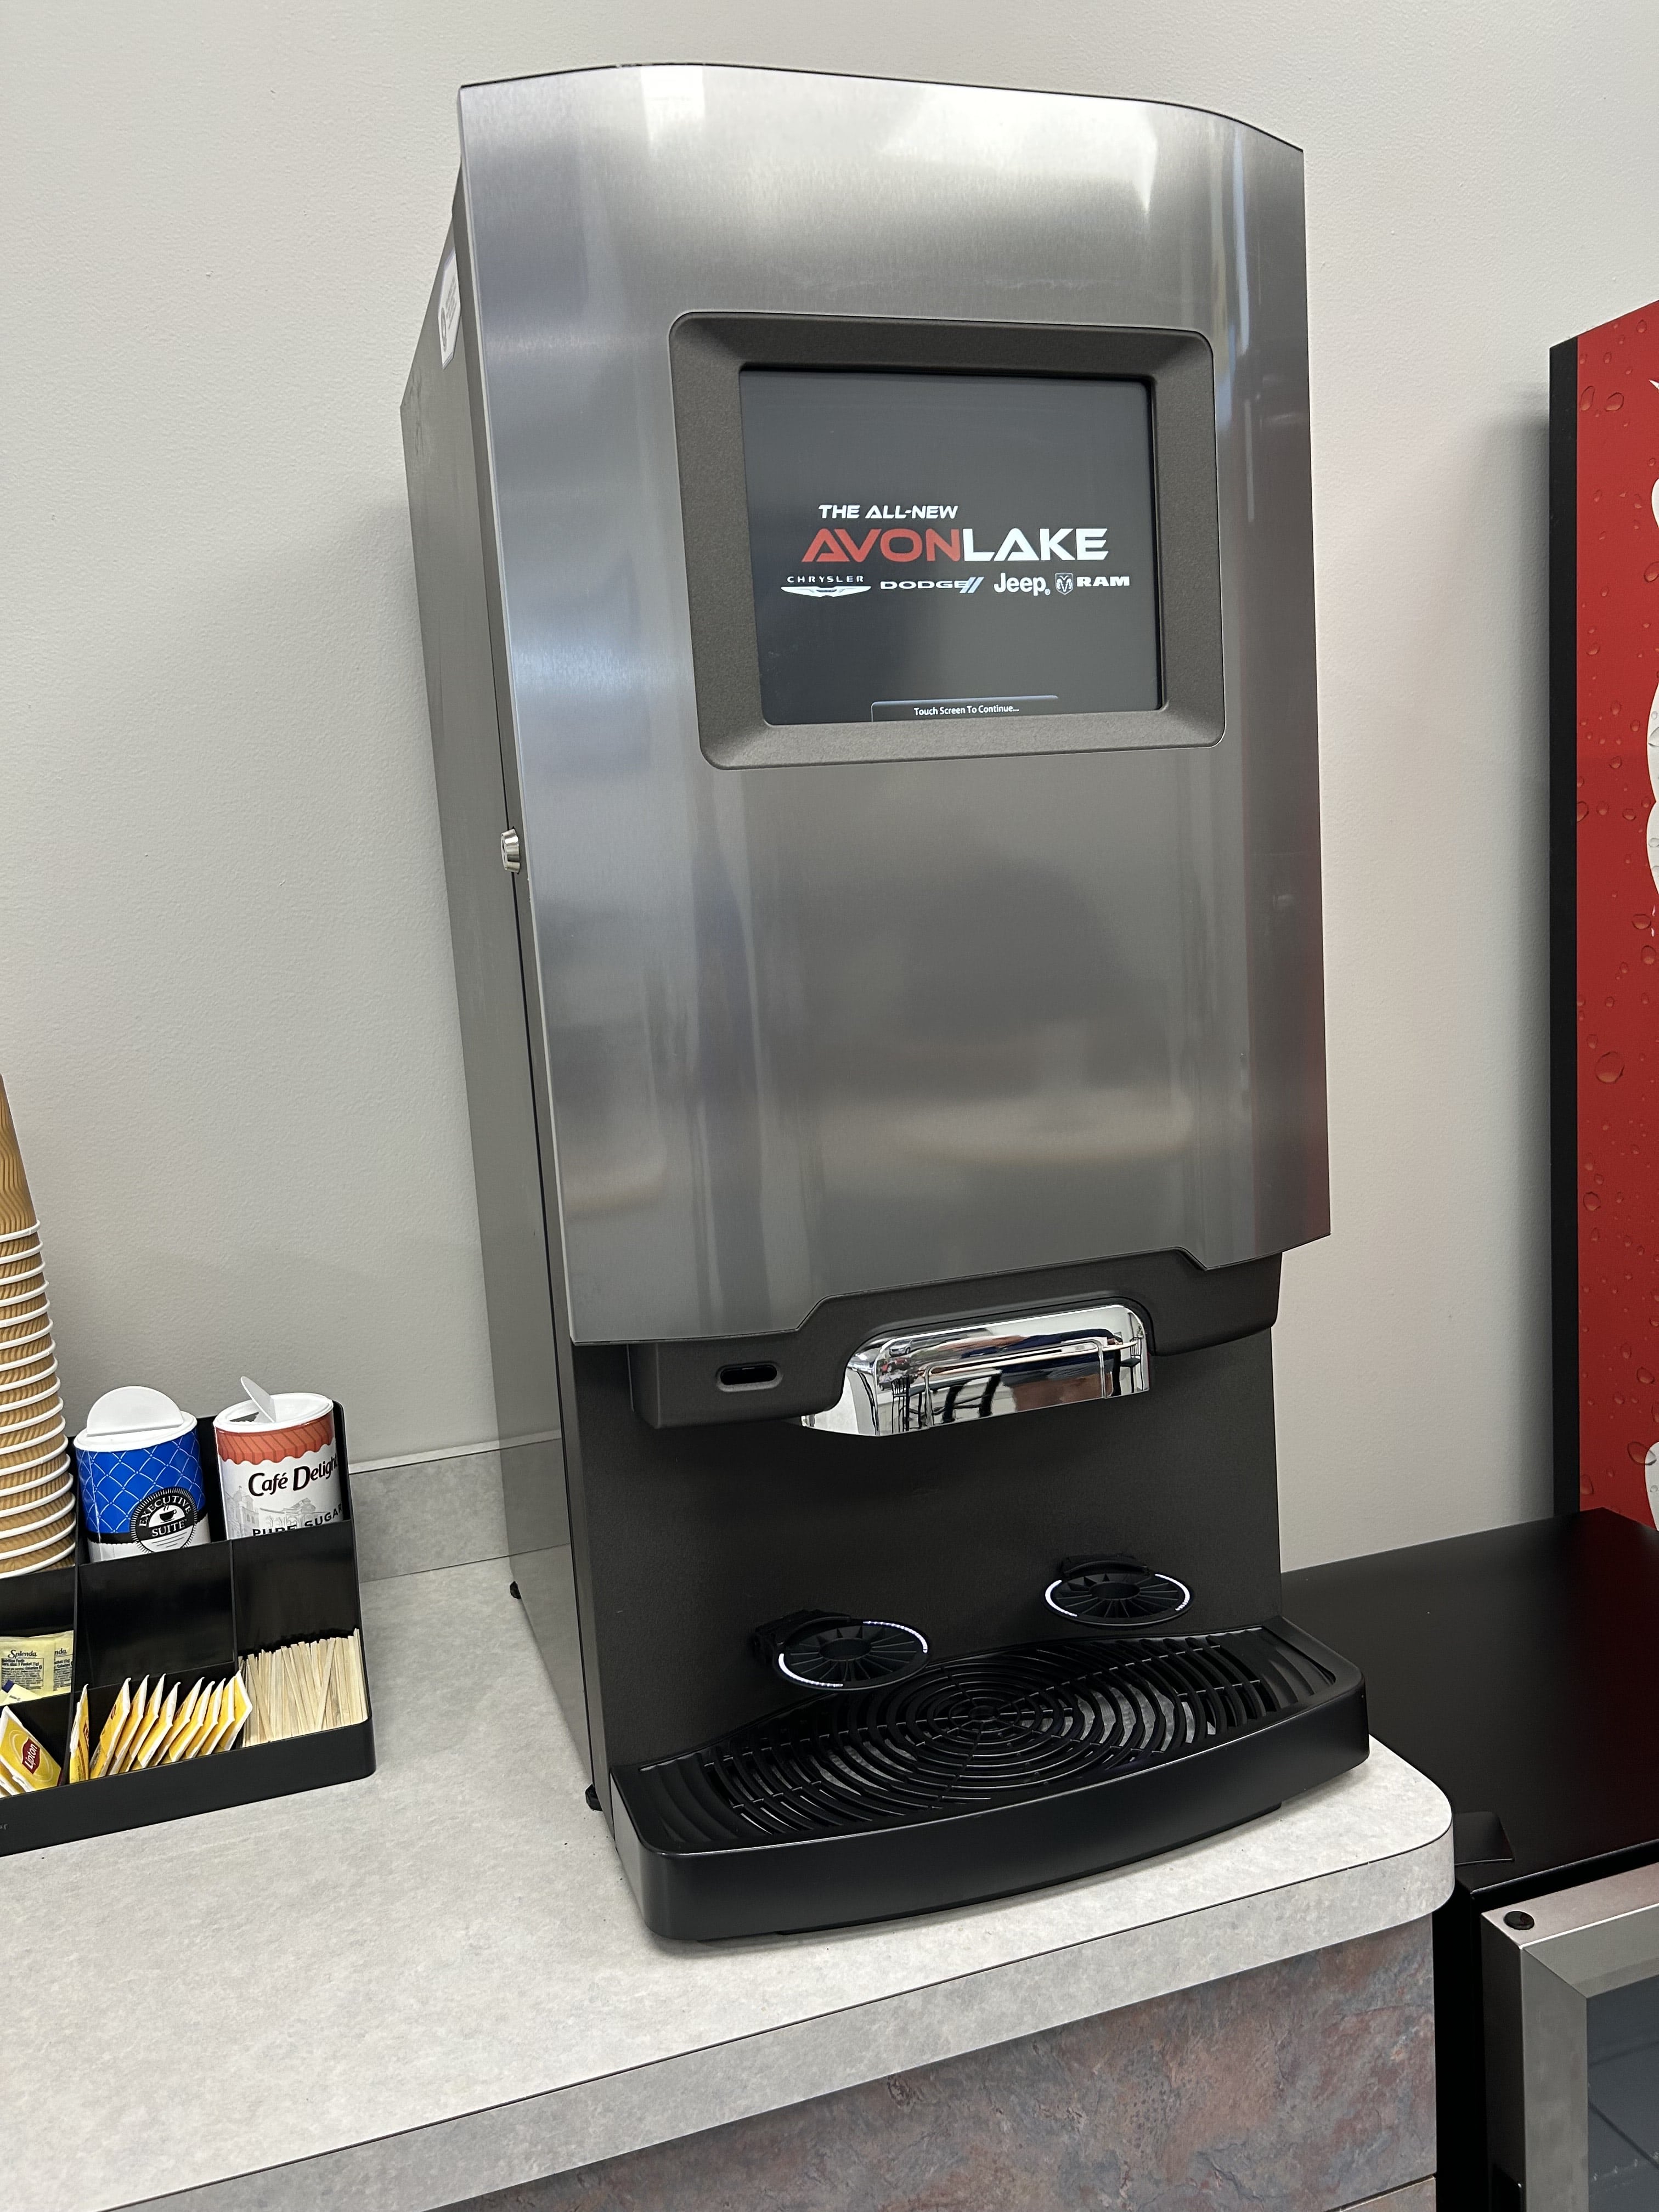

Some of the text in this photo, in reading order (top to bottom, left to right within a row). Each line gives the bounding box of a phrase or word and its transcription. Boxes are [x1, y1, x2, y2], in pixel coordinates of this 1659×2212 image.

[819, 505, 958, 519] THE ALL-NEW
[802, 528, 1109, 562] AVONLAKE
[880, 580, 970, 589] DODGE
[1076, 576, 1130, 587] RAM
[913, 704, 1019, 716] Touch Screen To Continue...
[248, 1472, 288, 1497] Café
[139, 1495, 192, 1527] EXECUTIVE
[151, 1520, 185, 1537] SUITE
[8, 1649, 37, 1658] Splenda
[24, 1743, 38, 1770] Lipton
